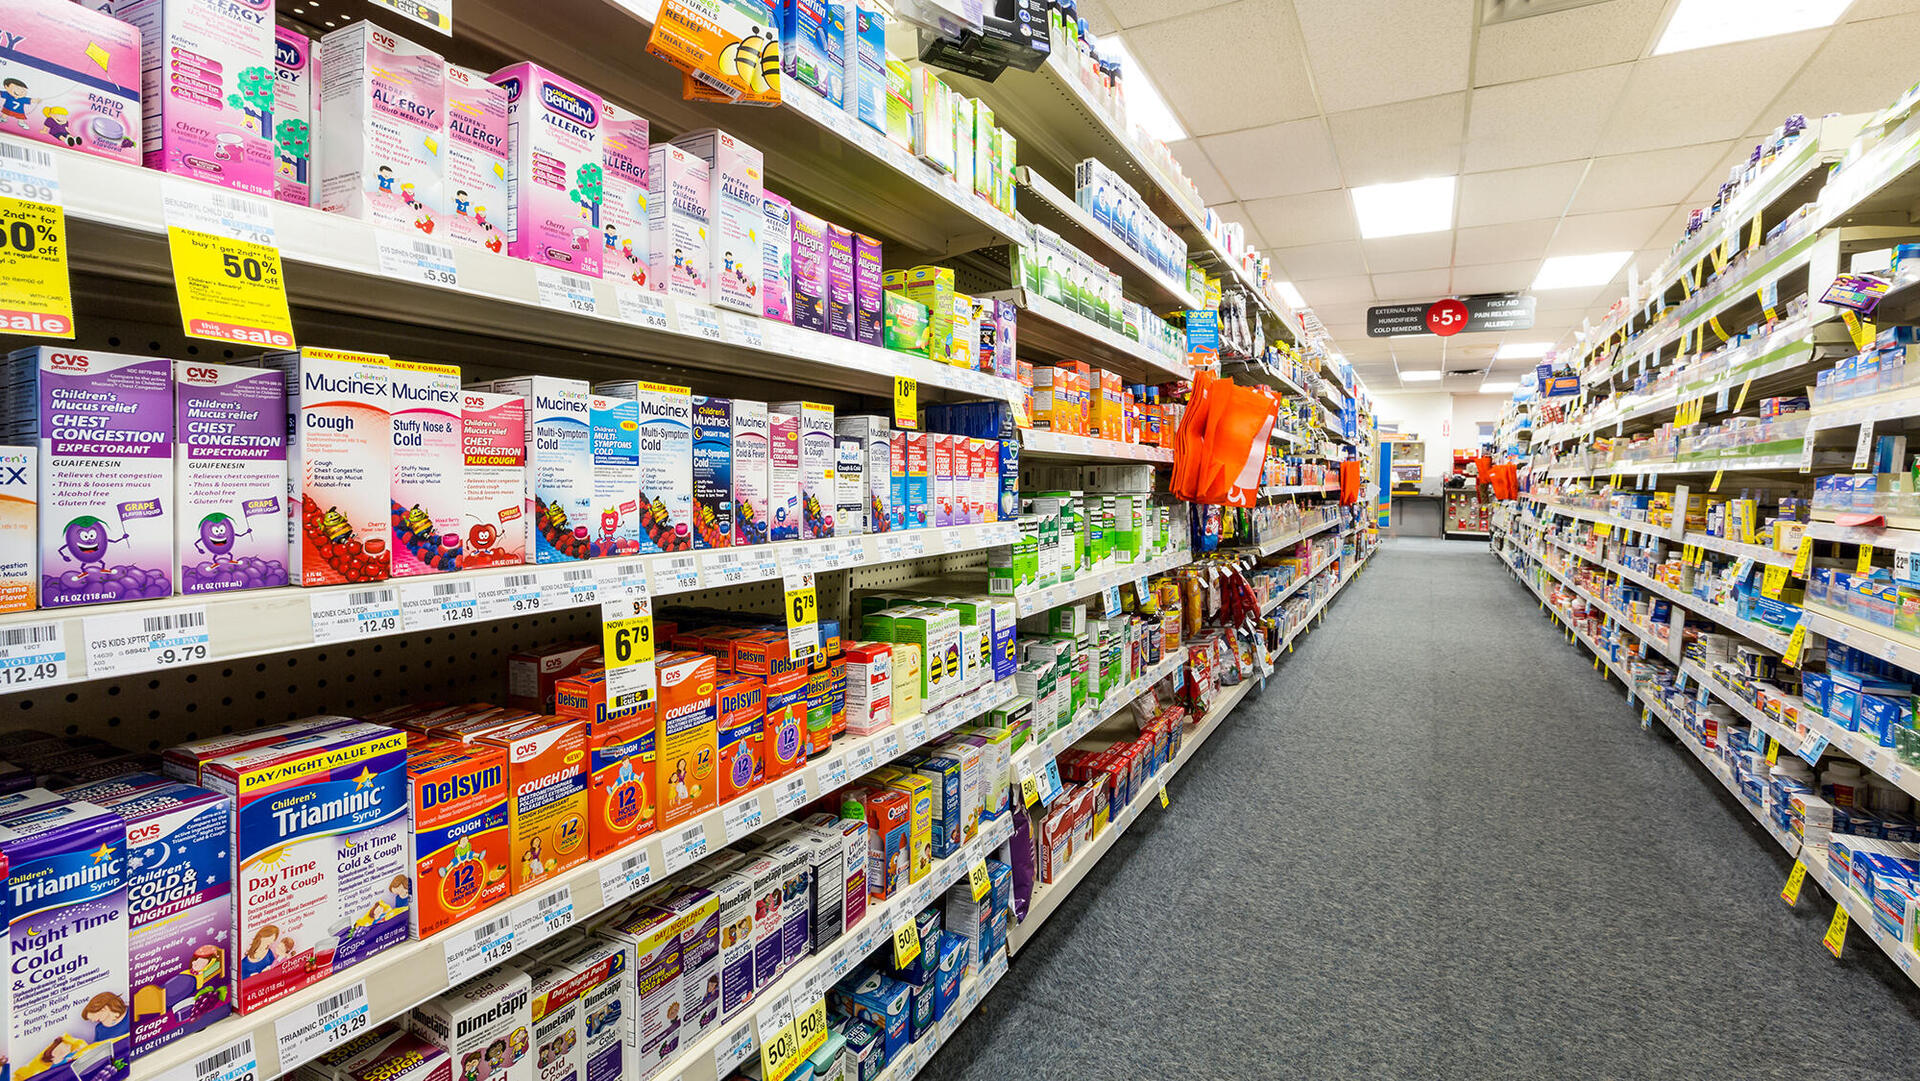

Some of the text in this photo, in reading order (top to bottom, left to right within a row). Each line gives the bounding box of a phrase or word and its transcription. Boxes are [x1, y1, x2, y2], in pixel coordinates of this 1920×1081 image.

[665, 9, 703, 32] RELIEF
[667, 1, 723, 37] SEASONAL
[372, 32, 395, 48] CVS
[659, 31, 704, 61] TRIAL SIZE
[450, 67, 469, 82] CVS
[88, 92, 124, 111] RAPID
[90, 102, 121, 118] MELT
[372, 89, 436, 120] ALLERGY
[544, 89, 595, 125] Benadryl
[176, 120, 210, 138] Cherry
[450, 120, 502, 148] ALLERGY
[541, 112, 595, 142] ALLERGY
[722, 183, 760, 205] ALLERGY
[672, 198, 707, 217] ALLERGY
[40, 216, 56, 224] for
[192, 239, 208, 248] buy
[793, 231, 824, 252] Allegra
[39, 246, 57, 255] off
[223, 253, 277, 282] 50%
[646, 316, 667, 328] $8.49
[1378, 316, 1418, 324] HUMIDIFIERS
[1432, 314, 1439, 322] b
[1440, 310, 1453, 325] 5
[1484, 320, 1515, 328] ALLERGY
[196, 328, 288, 346] week's sale
[50, 353, 89, 367] CVS
[310, 351, 384, 365] NEW FORMULA
[51, 365, 90, 373] pharmacy
[187, 367, 218, 379] CVS
[415, 365, 456, 374] FORMULA
[305, 373, 387, 396] Mucinex
[392, 382, 459, 403] Mucinex
[51, 389, 117, 402] Children's
[465, 396, 485, 406] CVS
[51, 400, 138, 414] Mucus relief
[188, 400, 241, 410] Children's
[641, 401, 688, 418] Mucinex
[52, 414, 109, 428] CHEST
[188, 410, 258, 421] Mucus relief
[306, 414, 354, 430] Cough
[188, 422, 235, 433] CHEST
[393, 420, 452, 433] Stuffy Nose &
[52, 428, 165, 443] CONGESTION
[189, 435, 281, 446] CONGESTION
[393, 433, 422, 446] Cold
[464, 437, 493, 447] CHEST
[57, 443, 150, 454] EXPECTORANT
[193, 448, 269, 457] EXPECTORANT
[464, 446, 521, 456] CONGESTION
[641, 439, 661, 450] Cold
[52, 460, 121, 468] GUAIFENESIN
[467, 456, 516, 465] PLUS COUGH
[117, 472, 162, 480] congestion
[124, 502, 154, 510] GRAPE
[678, 577, 696, 587] $16.99
[61, 594, 70, 602] FL
[71, 594, 81, 602] OZ
[83, 592, 100, 601] (118
[101, 591, 116, 600] mL)
[443, 609, 473, 621] $12.49
[607, 621, 623, 629] NOW
[91, 632, 166, 649] CVS KIDS XPTRT GRP
[157, 645, 206, 664] $9.79
[665, 671, 681, 681] CVS
[558, 693, 588, 708] Delsym
[665, 698, 711, 718] COUGH DM
[722, 688, 761, 714] Delsym
[516, 742, 537, 756] CVS
[246, 737, 401, 788] DAY/NIGHT VALUE PACK
[422, 765, 502, 809] Delsym
[518, 765, 580, 795] COUGH DM
[271, 792, 317, 811] Children's
[618, 787, 636, 807] 12
[273, 787, 382, 837] Triaminic
[352, 808, 381, 823] Syrup
[888, 802, 908, 820] OCEAN
[128, 824, 160, 841] CVS
[448, 821, 480, 839] COUGH
[562, 818, 577, 837] 12
[337, 833, 397, 860] Night Time
[337, 844, 402, 874] Cold & Cough
[8, 867, 53, 885] Children's
[129, 860, 190, 887] Children's
[249, 861, 316, 892] Day Time
[453, 866, 474, 888] 12
[9, 859, 120, 907] Triaminic
[90, 878, 119, 891] Syrup
[128, 869, 197, 900] COLD &
[249, 873, 324, 907] Cold & Cough
[454, 883, 475, 896] HOUR
[482, 883, 505, 898] Orange
[629, 876, 649, 890] $19.99
[129, 881, 196, 915] COUGH
[133, 893, 203, 926] NIGHTTIME
[11, 909, 119, 955] Night Time
[11, 944, 63, 974] Cold
[12, 980, 24, 991] &
[30, 955, 88, 984] Cough
[584, 981, 621, 1009] Dimetapp
[457, 992, 528, 1038] Dimetapp
[135, 1015, 168, 1035] Grape
[280, 1011, 340, 1045] TRIAMINIC DT/NT
[329, 1015, 367, 1042] $13.29
[536, 1009, 575, 1039] Dimetapp
[846, 1023, 866, 1040] CHEST
[852, 1031, 867, 1044] RUB
